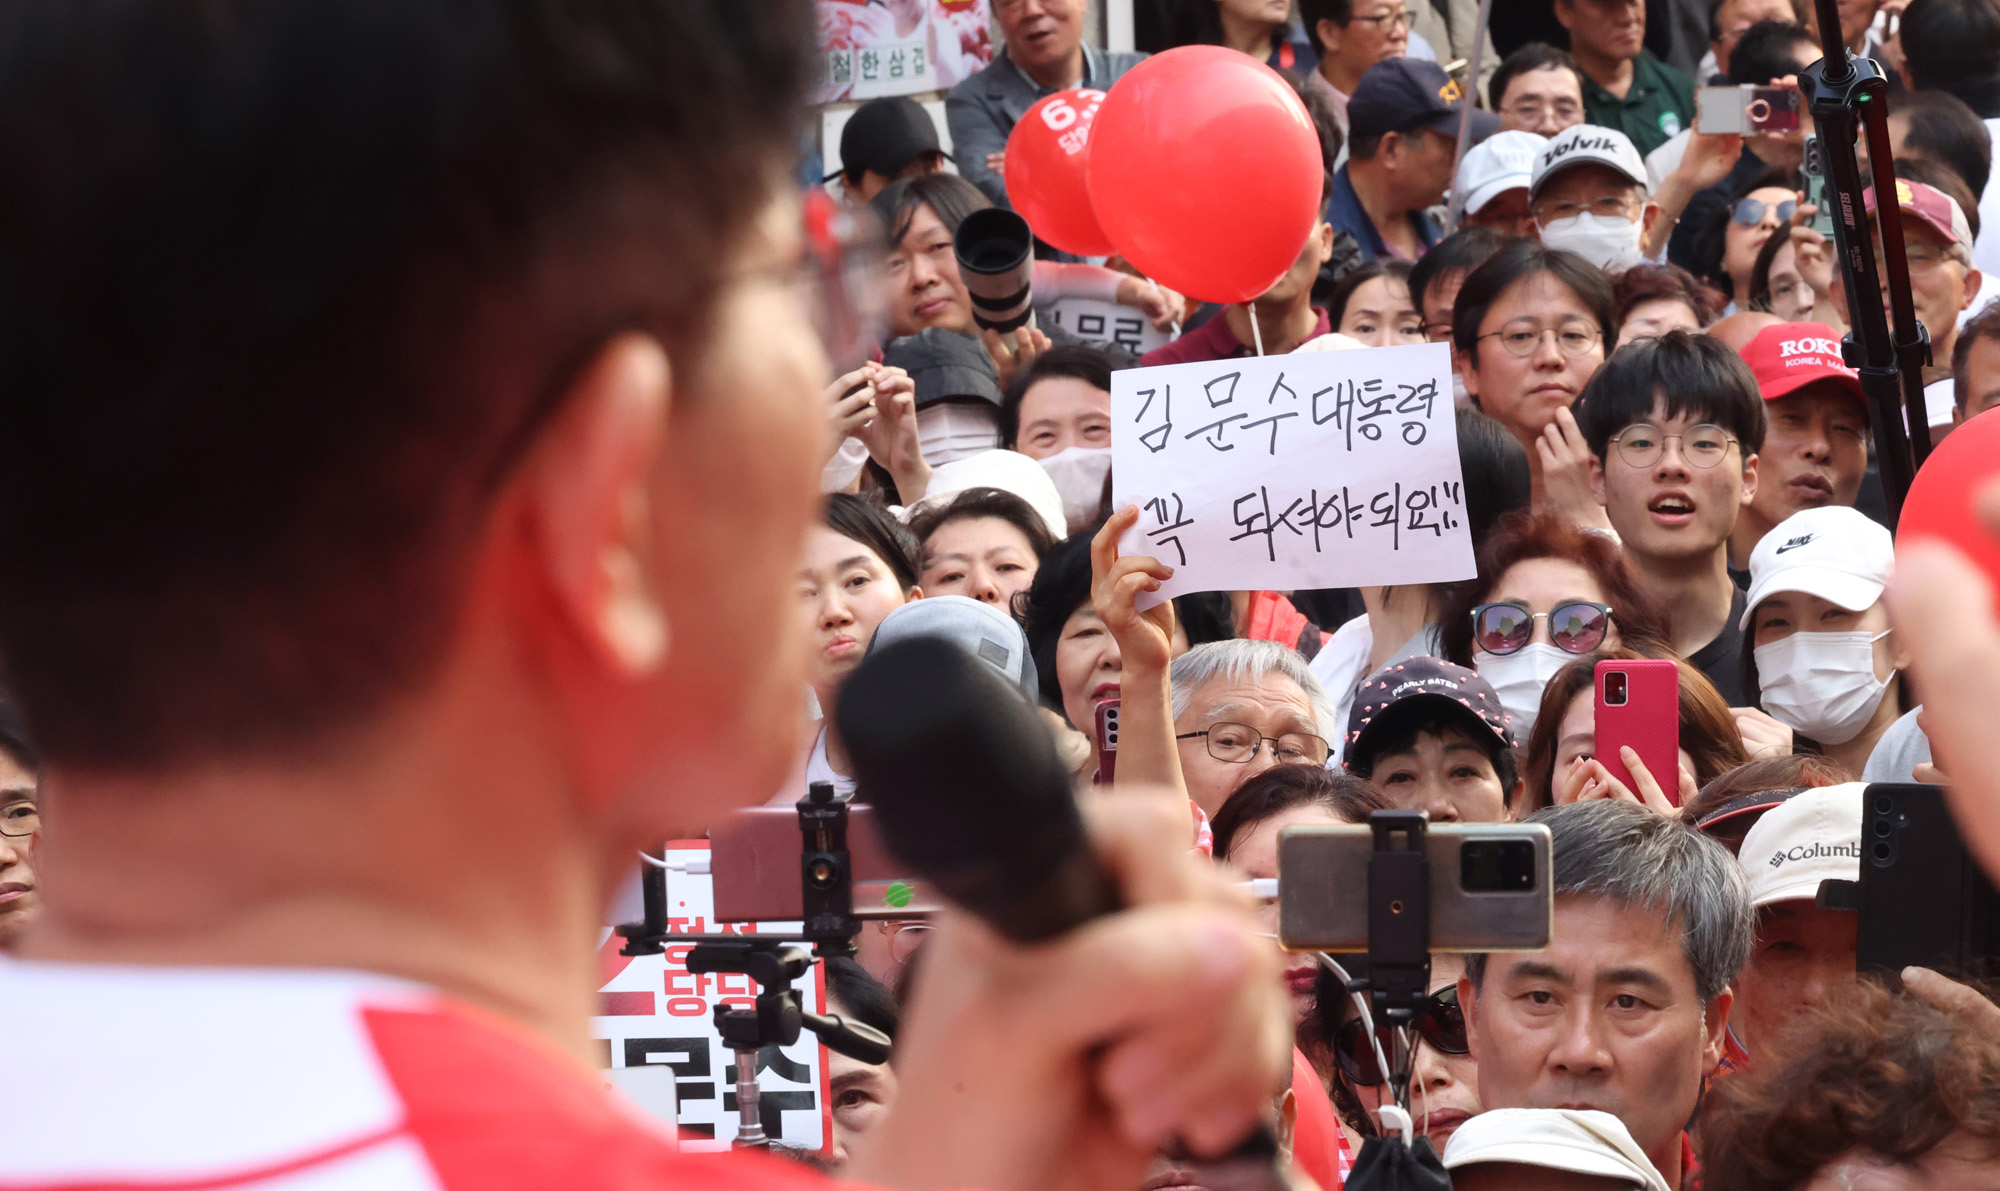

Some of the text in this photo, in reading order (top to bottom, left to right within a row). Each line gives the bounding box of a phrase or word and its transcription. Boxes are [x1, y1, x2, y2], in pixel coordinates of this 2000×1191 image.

[1542, 134, 1619, 167] Volvik
[1785, 357, 1822, 367] KOREA
[1144, 492, 1194, 566] 꼭
[1786, 533, 1814, 546] NIKE
[1392, 678, 1458, 697] PEARLY GATES
